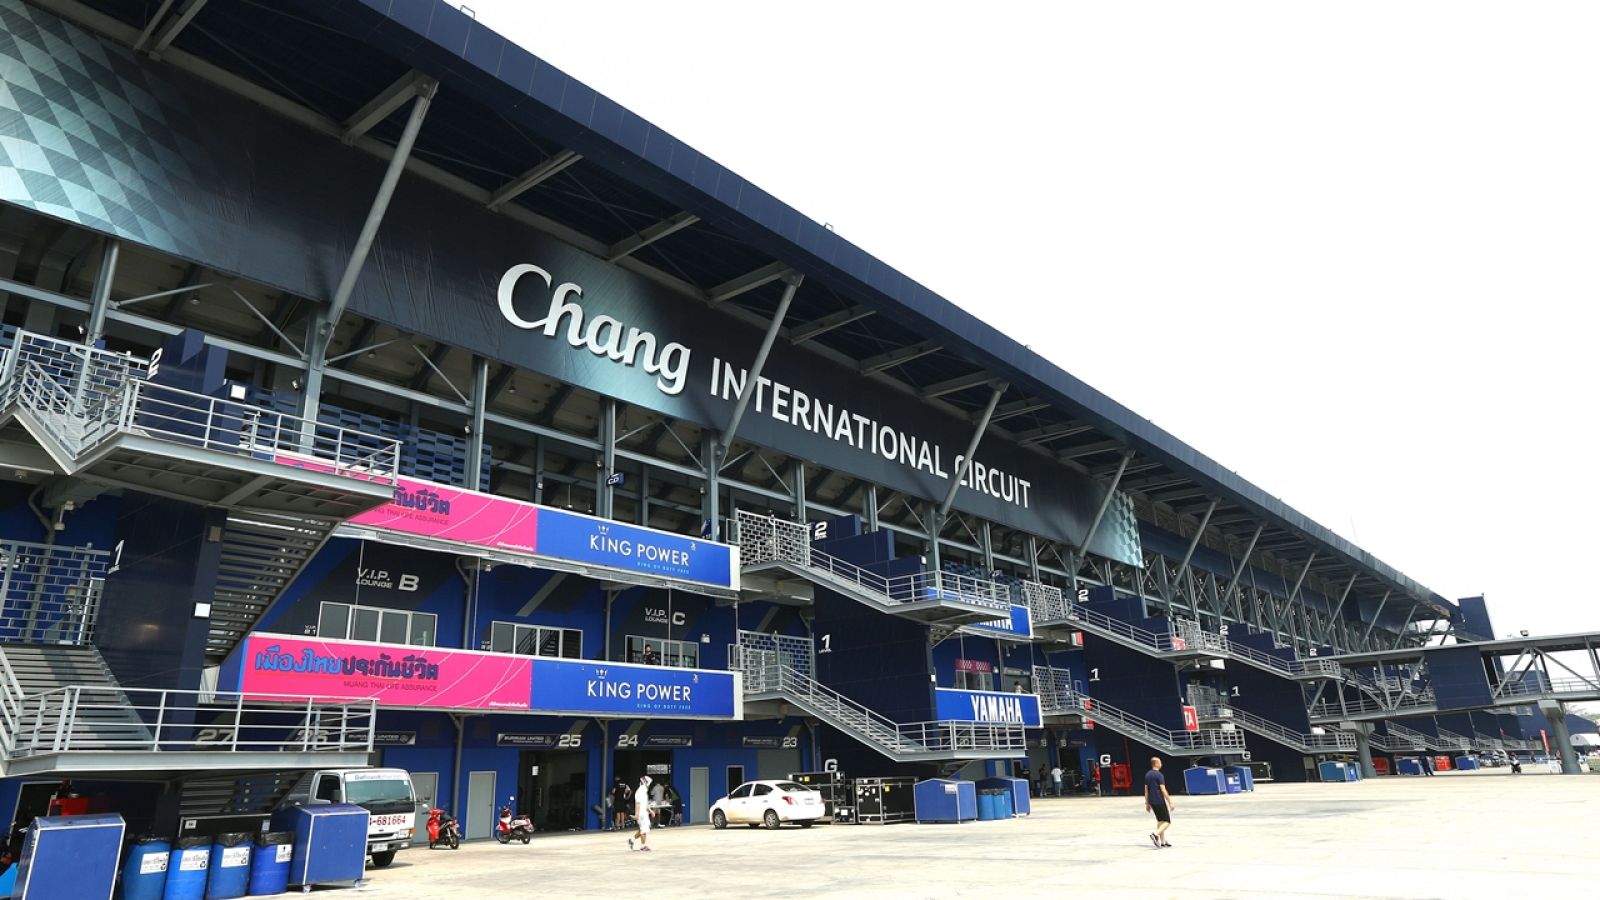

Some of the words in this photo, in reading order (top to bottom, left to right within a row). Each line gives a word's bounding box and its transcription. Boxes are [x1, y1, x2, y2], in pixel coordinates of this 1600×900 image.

[148, 347, 163, 374] 2
[497, 263, 691, 395] Chang
[710, 357, 948, 480] INTERNATIONAL
[954, 454, 1030, 509] CIRCUIT
[815, 521, 827, 536] 2
[115, 539, 125, 566] 1
[589, 533, 631, 556] KING
[637, 543, 689, 566] POWER
[356, 577, 392, 590] LOUNGE
[398, 574, 420, 592] B
[1078, 589, 1089, 600] 2
[645, 616, 669, 624] LOUNGE
[672, 612, 686, 626] C
[1220, 625, 1229, 634] 2
[821, 634, 830, 649] 1
[1091, 668, 1099, 679] 1
[344, 681, 368, 689] MUANG
[386, 682, 399, 690] LIFE
[401, 683, 437, 692] ASSURANCE
[587, 680, 631, 699] KING
[637, 684, 691, 702] POWER
[970, 694, 1024, 723] YAMAHA
[195, 729, 236, 744] 27
[558, 734, 582, 747] 25
[617, 734, 639, 747] 24
[782, 736, 797, 748] 23
[825, 758, 838, 773] G
[1100, 754, 1111, 766] G
